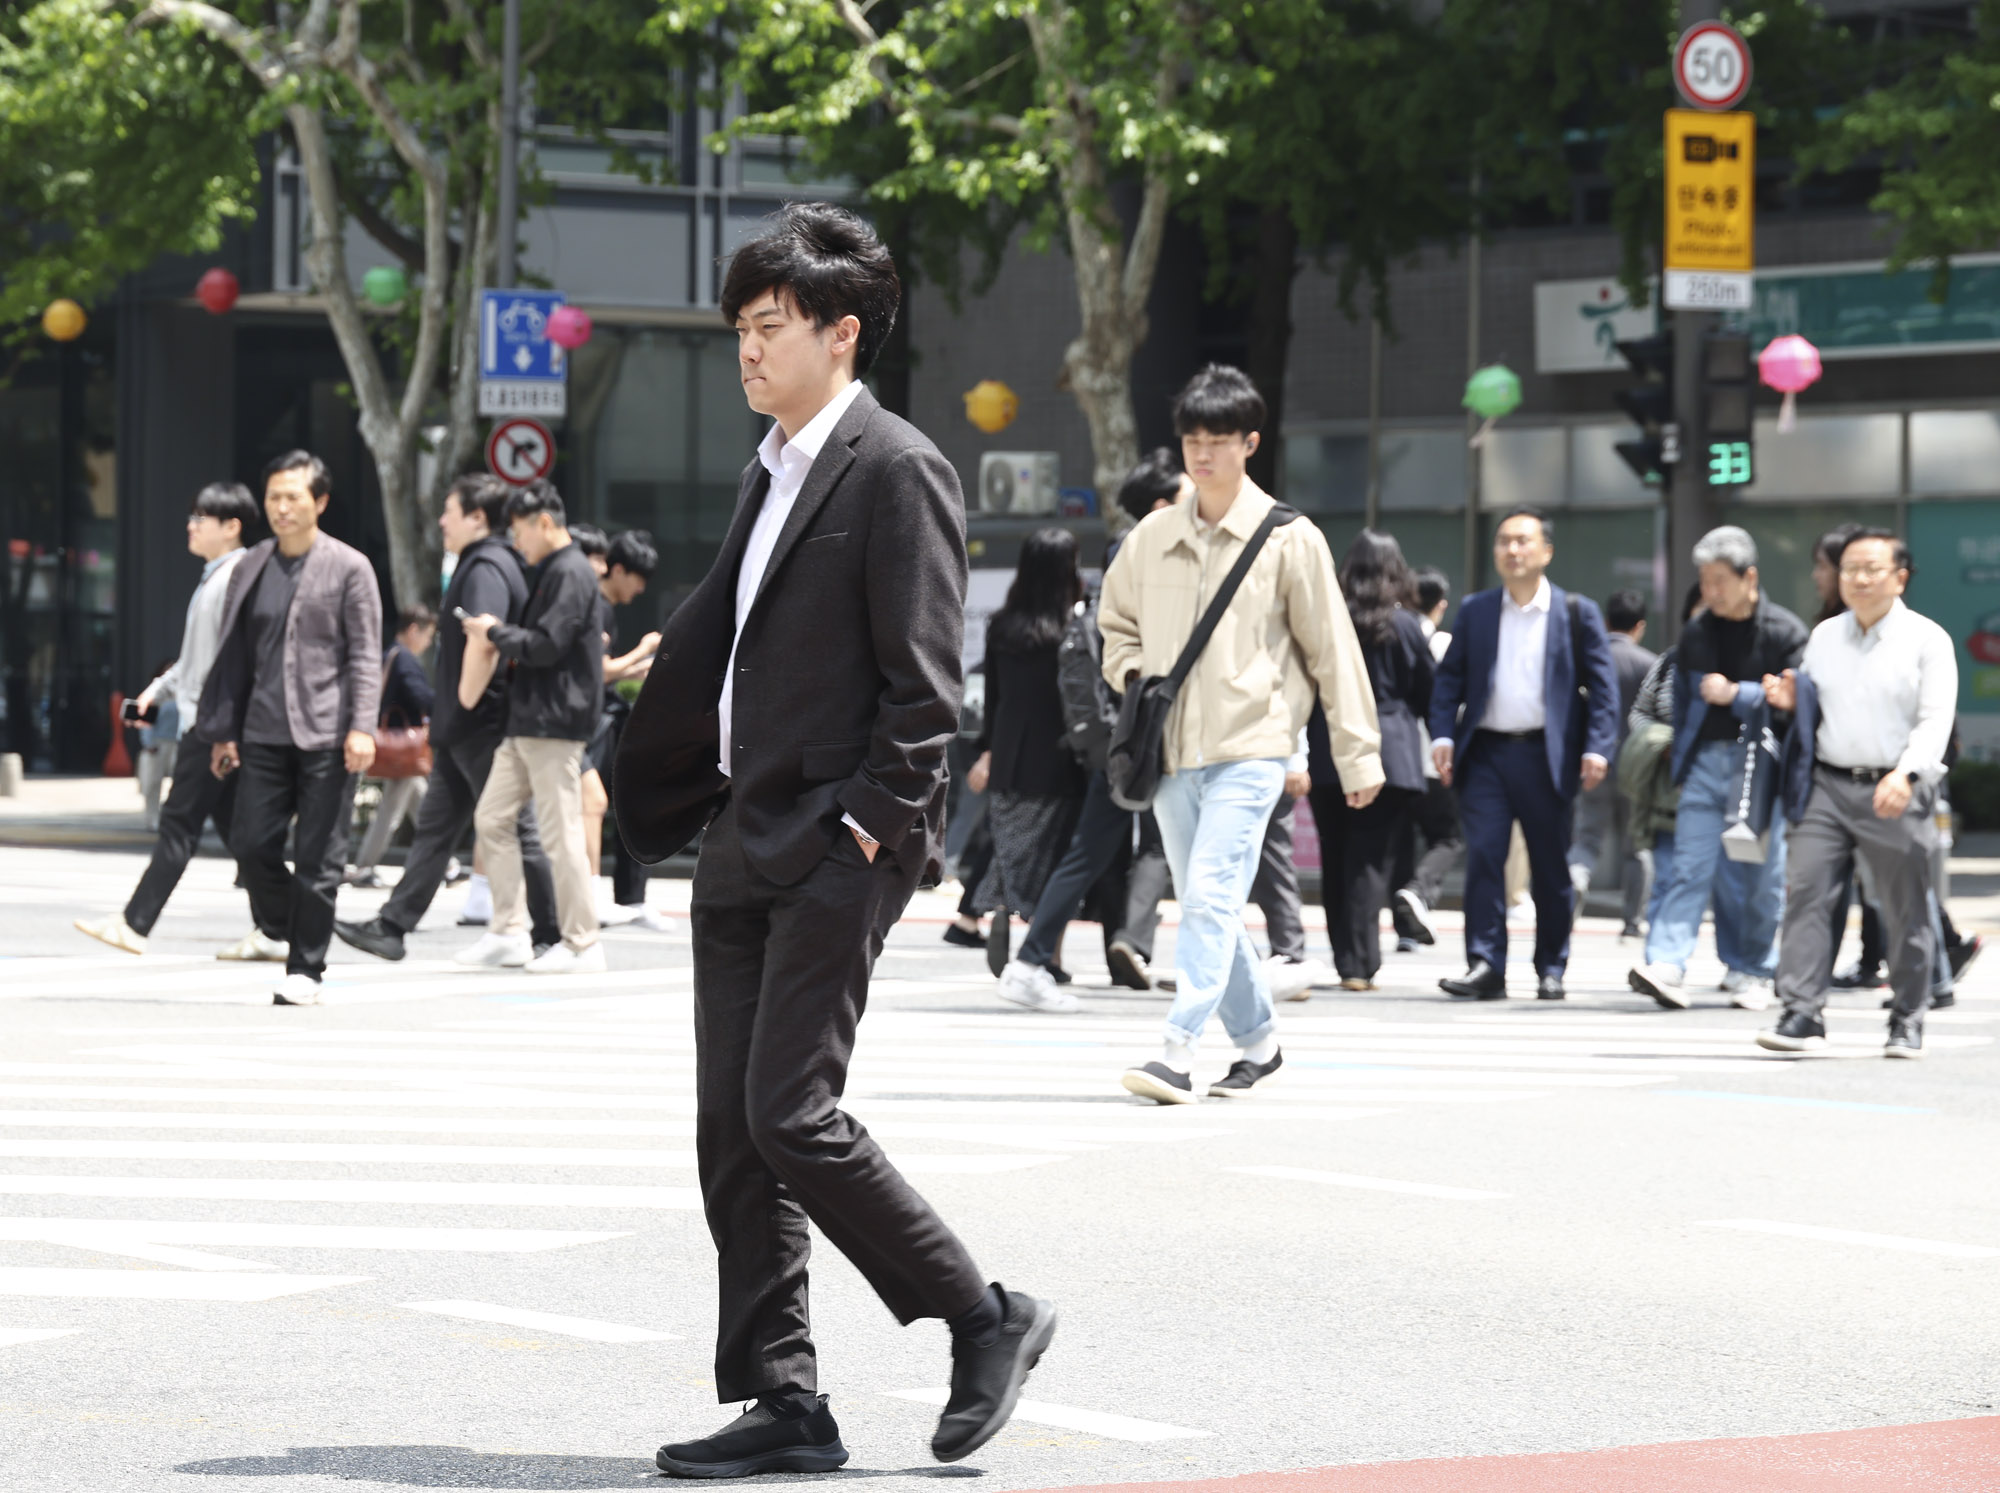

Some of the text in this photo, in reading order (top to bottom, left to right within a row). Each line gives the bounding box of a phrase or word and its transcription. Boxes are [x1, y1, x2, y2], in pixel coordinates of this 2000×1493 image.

[1693, 47, 1736, 86] 50
[1686, 275, 1740, 303] 250m
[1708, 441, 1751, 485] 33
